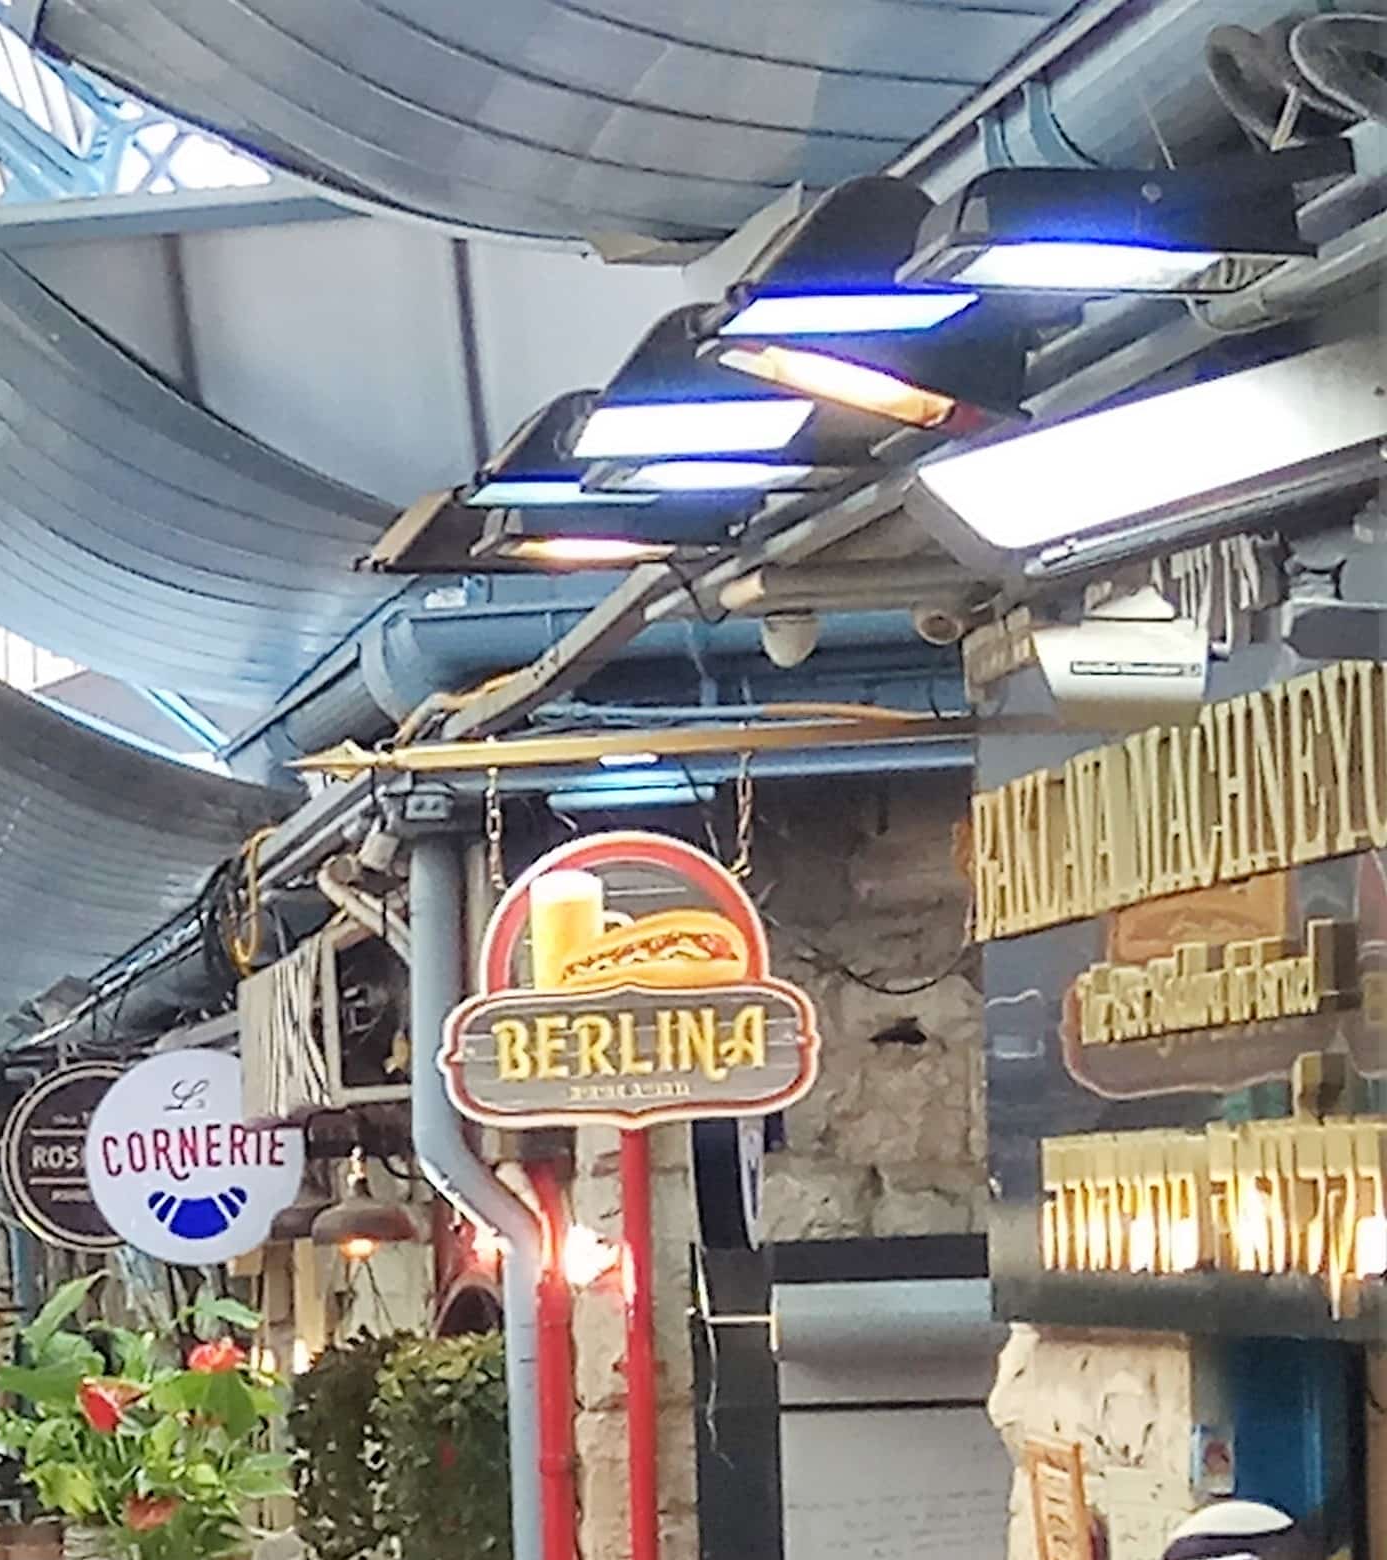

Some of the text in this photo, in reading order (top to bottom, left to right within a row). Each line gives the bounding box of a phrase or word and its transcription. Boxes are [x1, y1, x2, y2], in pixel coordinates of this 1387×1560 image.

[972, 747, 1118, 941] BAKLAVA
[491, 1005, 767, 1081] BERLINA
[32, 1145, 80, 1169] ROS
[102, 1124, 286, 1180] CORNERIE
